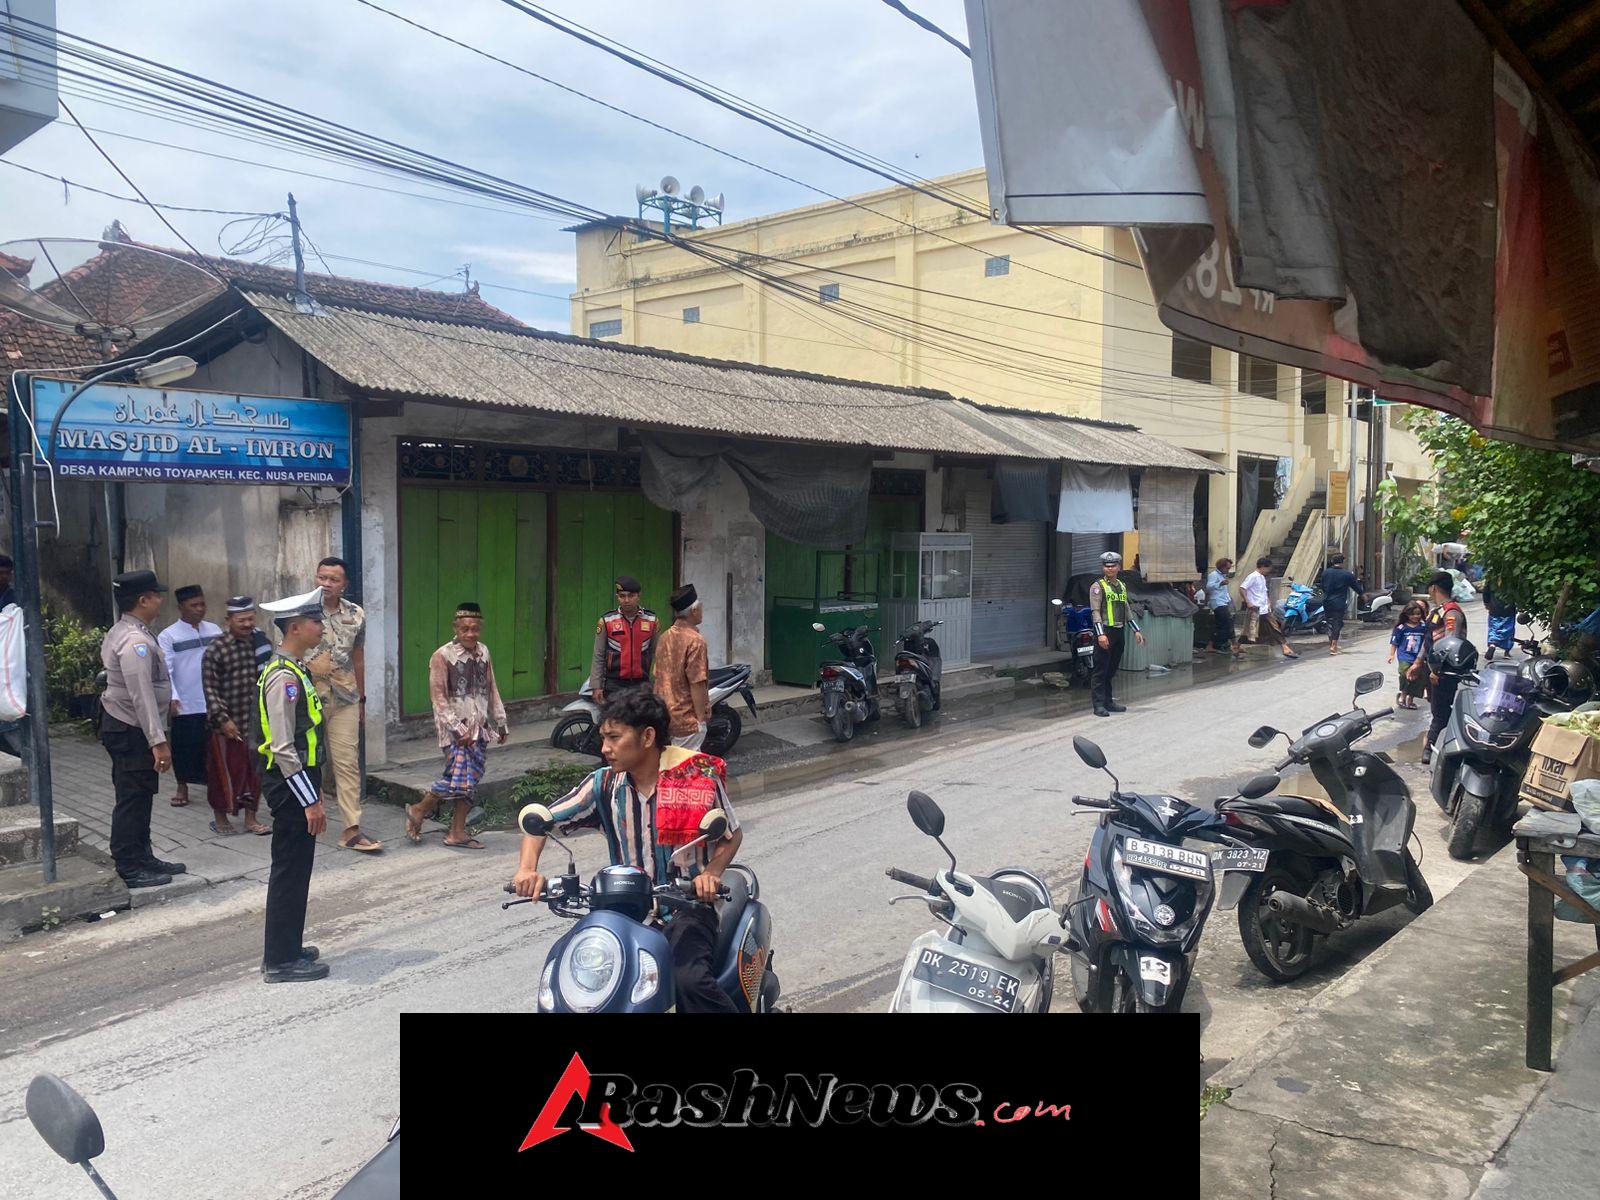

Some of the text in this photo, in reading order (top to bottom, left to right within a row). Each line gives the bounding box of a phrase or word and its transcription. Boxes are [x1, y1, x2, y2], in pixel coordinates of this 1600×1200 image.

[58, 428, 180, 453] MASJID
[187, 435, 222, 455] AL
[245, 438, 334, 460] IMRON
[60, 464, 96, 475] DESA
[99, 465, 161, 478] KAMPUNG
[266, 472, 295, 481] NUSA
[296, 473, 334, 482] PENIDA
[1131, 840, 1138, 851] B
[1143, 843, 1174, 859] 5138
[1226, 849, 1249, 859] 3823
[922, 950, 1018, 997] DK 2519 EK
